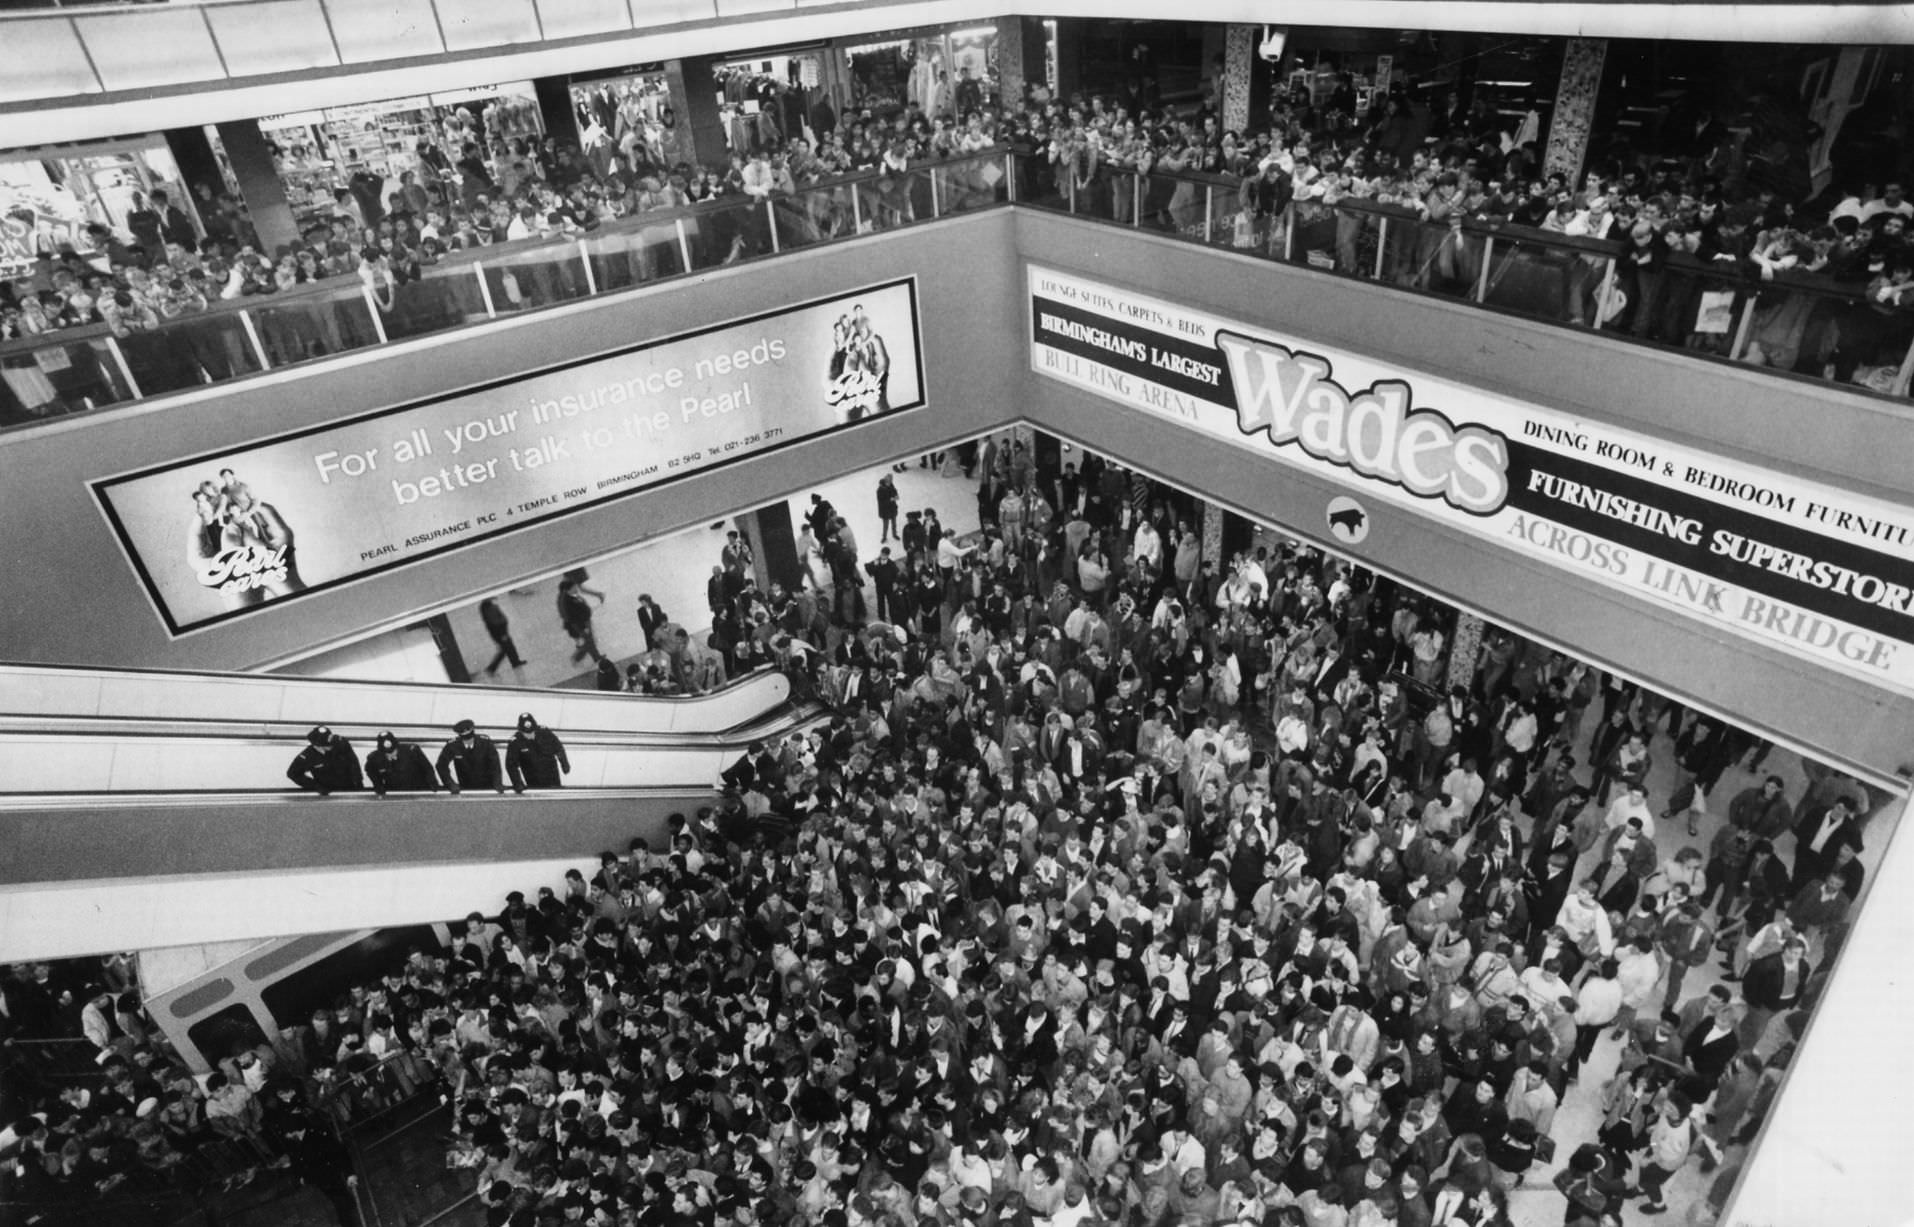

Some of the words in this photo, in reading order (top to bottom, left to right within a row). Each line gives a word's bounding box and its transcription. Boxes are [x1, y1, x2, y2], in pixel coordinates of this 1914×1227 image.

[1040, 311, 1148, 363] BIRMINGHAM'S
[1151, 346, 1222, 387] LARGEST
[1041, 279, 1077, 298] LOUNGE
[1118, 302, 1165, 325] CARPETS
[1167, 317, 1174, 328] &
[1178, 318, 1206, 337] BEDS
[314, 447, 379, 484] For
[392, 427, 433, 464] all
[445, 409, 518, 454] your
[529, 367, 684, 425] insurance
[695, 337, 787, 381] needs
[1045, 348, 1081, 377] BULL
[1089, 362, 1131, 396] RING
[1140, 382, 1200, 420] ARENA
[1216, 338, 1505, 510] Wades
[391, 457, 499, 505] better
[509, 434, 571, 472] talk
[581, 424, 614, 449] to
[622, 410, 671, 438] the
[680, 381, 752, 424] Pearl
[1524, 419, 1589, 451] DINING
[1596, 439, 1657, 472] ROOM
[1662, 462, 1675, 477] &
[1684, 466, 1796, 514] BEDROOM
[360, 543, 399, 562] PEARL
[404, 519, 472, 549] ASSURANCE
[476, 512, 498, 527] PLC
[507, 507, 514, 516] 4
[518, 494, 559, 514] TEMPLE
[563, 485, 589, 500] ROW
[596, 464, 659, 491] BIRMINGHAM
[1527, 469, 1704, 547] FURNISHING
[1710, 529, 1914, 618] SUPERSTOR
[1506, 514, 1630, 577] ACROSS
[1641, 559, 1726, 613] LINK
[1740, 595, 1898, 671] BRIDGE
